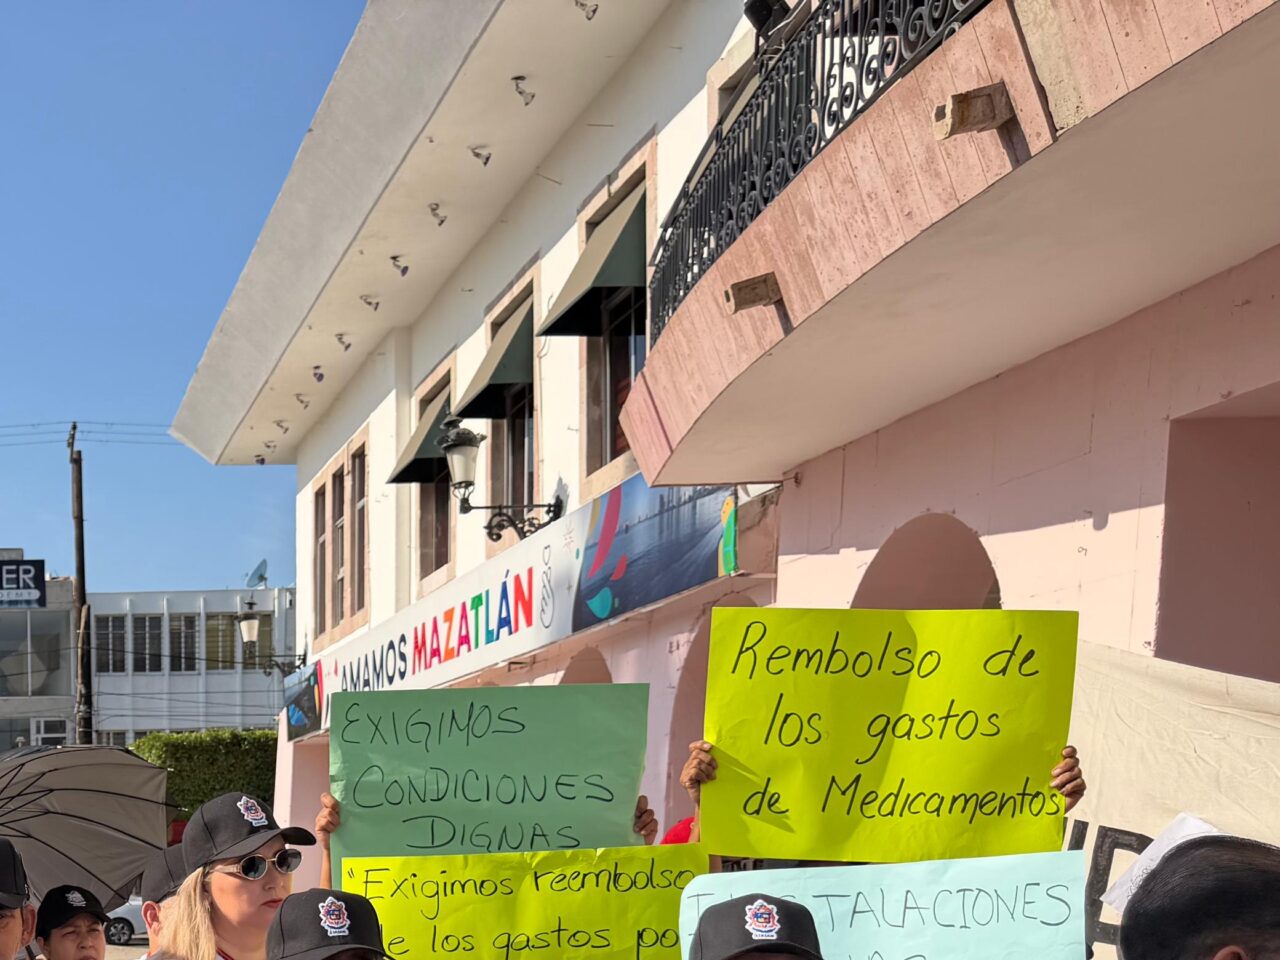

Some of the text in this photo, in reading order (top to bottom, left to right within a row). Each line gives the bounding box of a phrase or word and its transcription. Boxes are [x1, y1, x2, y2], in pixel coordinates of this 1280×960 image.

[412, 566, 533, 676] MAZATLÁN
[731, 621, 1040, 682] Rembolso de
[341, 701, 526, 754] EXIGIMOS
[763, 694, 1002, 765] los gastos
[353, 765, 615, 808] CONDICIONES
[742, 775, 1061, 824] de Medicamentos
[402, 814, 581, 854] DIGNAS
[534, 858, 695, 892] reembolso
[687, 882, 1072, 936] ITALACIONES
[432, 925, 475, 953] los
